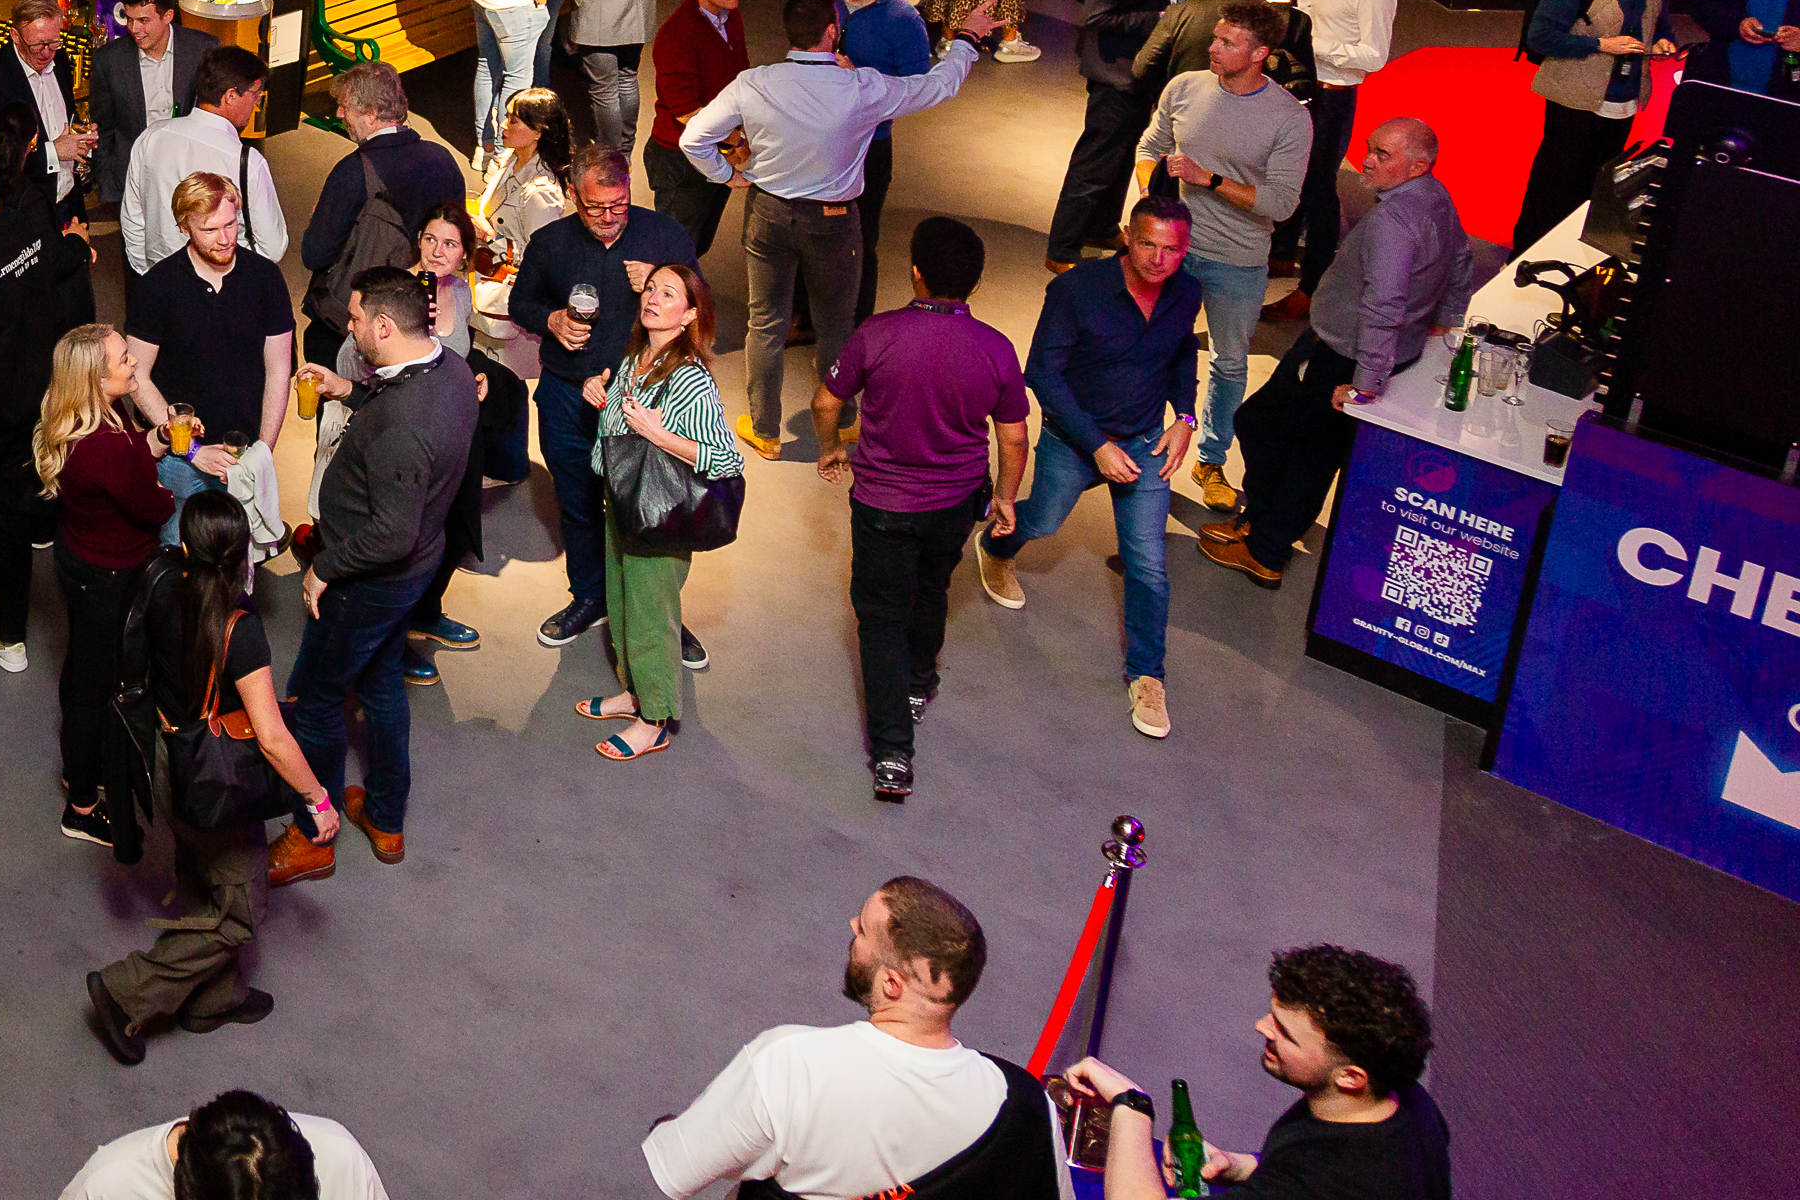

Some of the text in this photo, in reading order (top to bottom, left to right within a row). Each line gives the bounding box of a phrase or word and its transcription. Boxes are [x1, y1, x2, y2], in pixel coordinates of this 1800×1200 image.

[1381, 499, 1521, 560] to visit our website
[1394, 486, 1515, 542] SCAN HERE
[1352, 617, 1487, 678] GRAVITY-GLOBAL.COM/MAX
